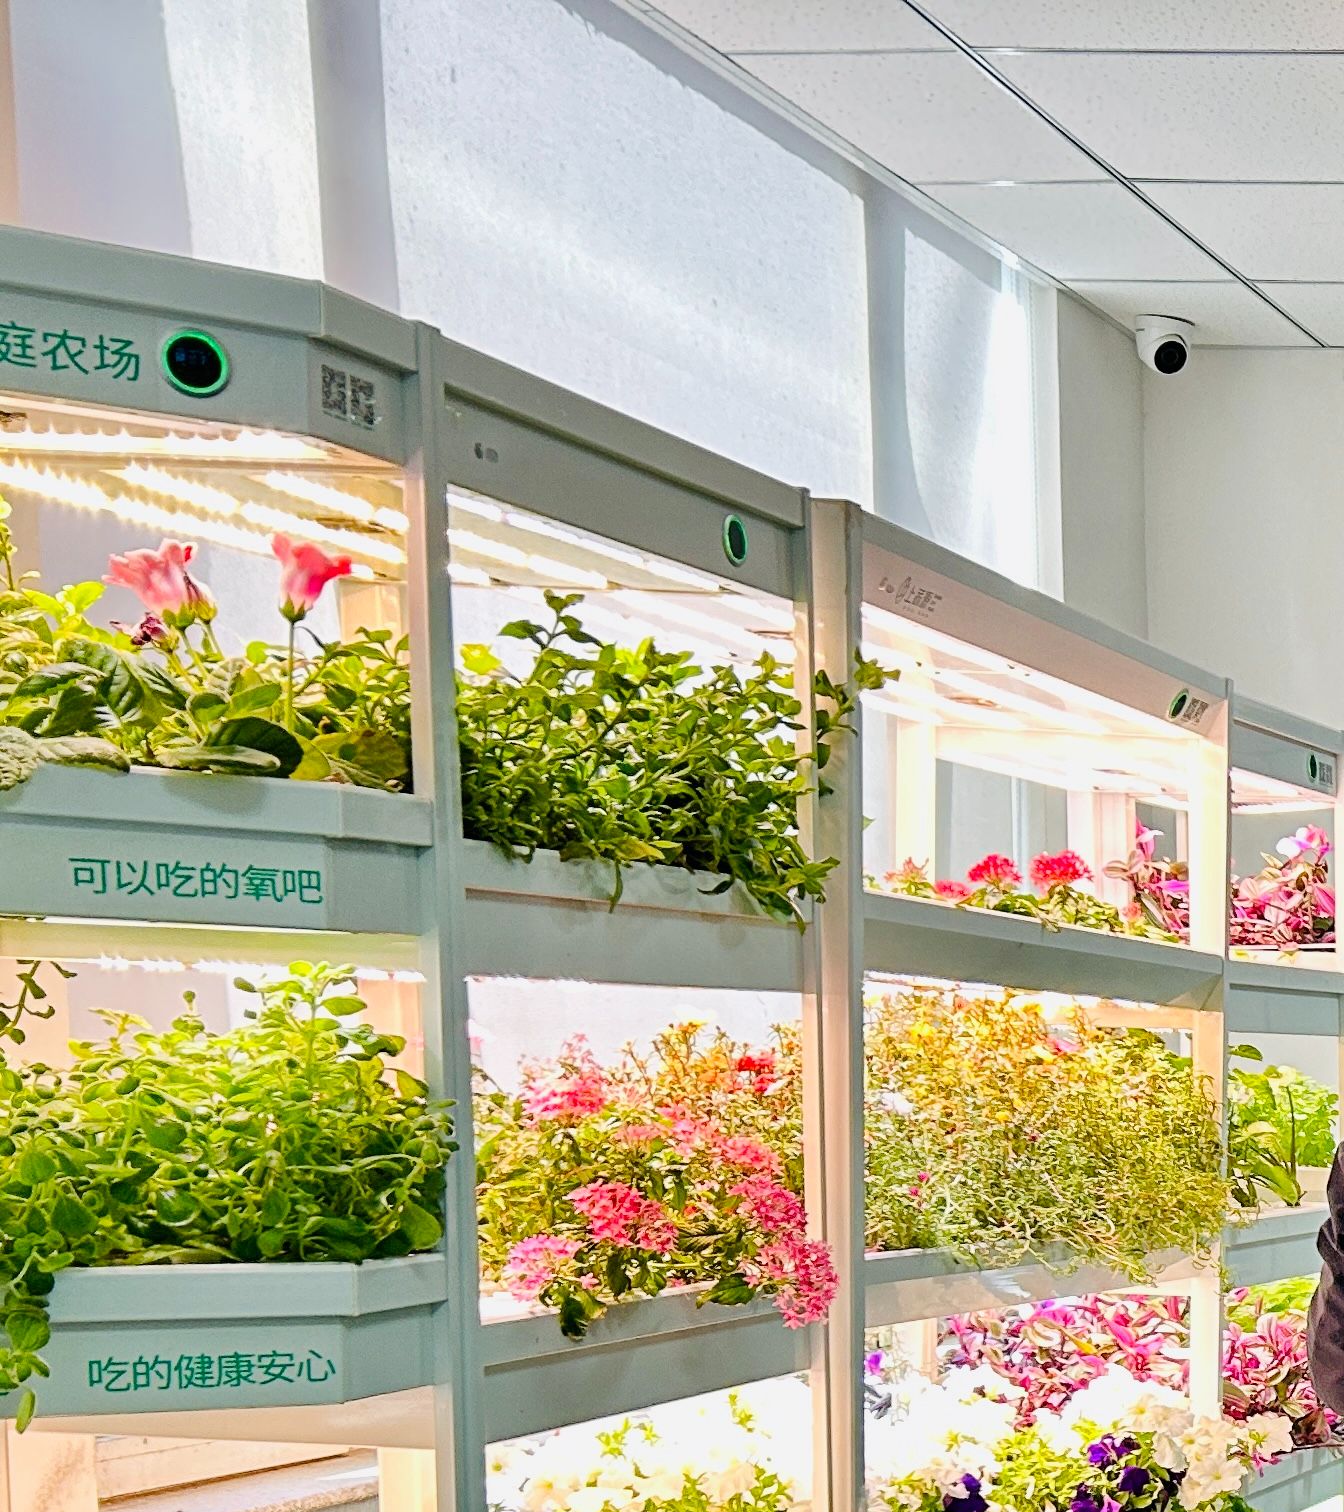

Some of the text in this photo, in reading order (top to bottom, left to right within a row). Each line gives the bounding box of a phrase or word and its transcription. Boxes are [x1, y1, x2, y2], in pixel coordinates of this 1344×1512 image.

[0, 320, 140, 382] 庭农场
[68, 856, 323, 904] 可以吃的氧吧
[88, 1349, 336, 1393] 吃的健康安心
